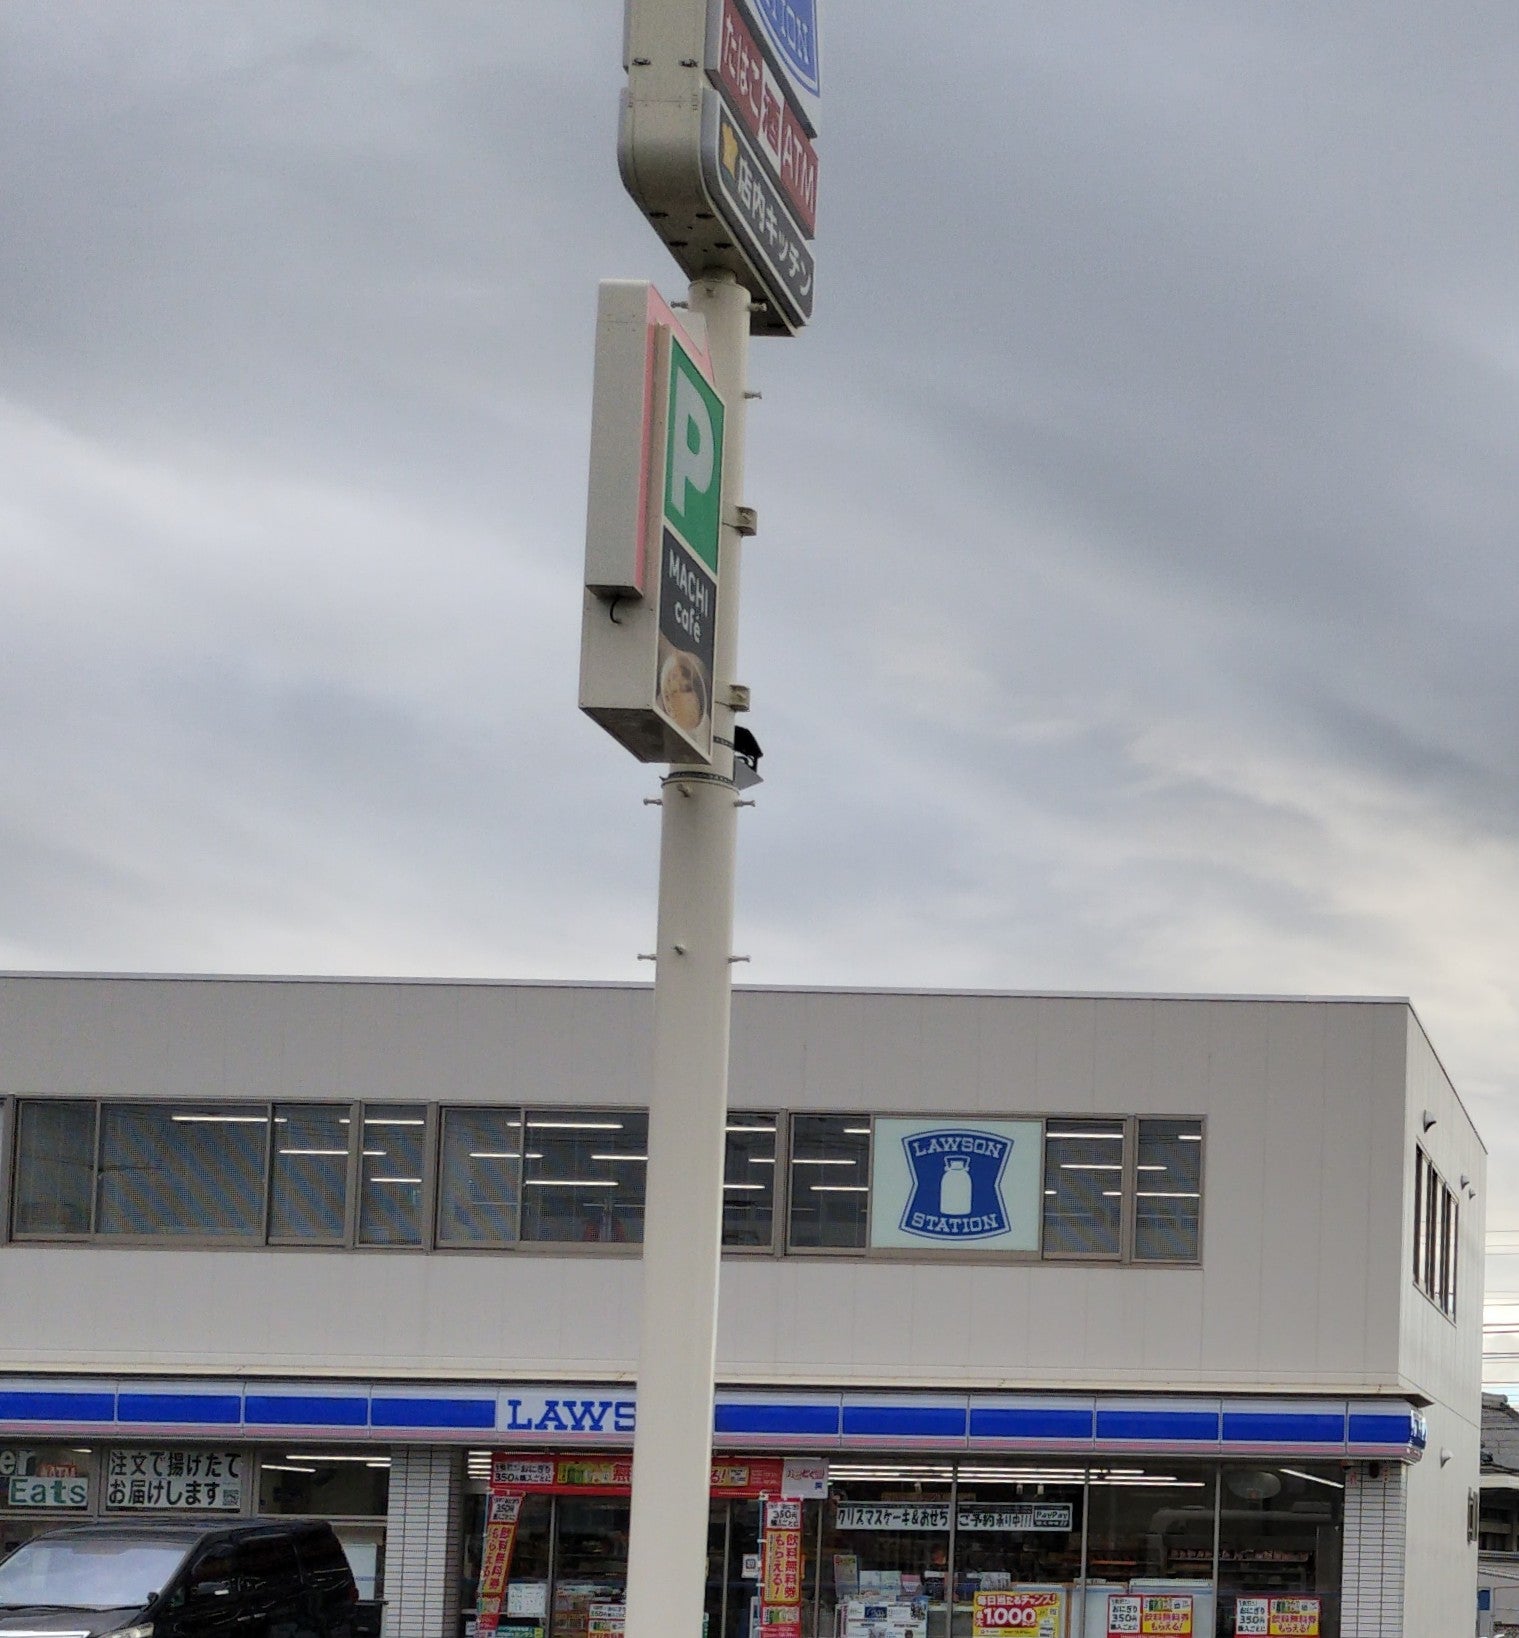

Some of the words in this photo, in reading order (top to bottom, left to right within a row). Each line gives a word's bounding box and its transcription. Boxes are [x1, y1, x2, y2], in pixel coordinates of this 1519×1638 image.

[725, 14, 760, 117] たばこ
[782, 125, 814, 214] ATM
[738, 156, 812, 296] 店内キッチン
[672, 366, 715, 517] P
[669, 548, 709, 617] MACHI
[674, 599, 702, 643] café
[912, 1137, 1003, 1159] LAWSON
[911, 1212, 999, 1233] STATION
[110, 1451, 241, 1478] 注文で揚げたて
[10, 1478, 86, 1504] Eats
[109, 1479, 219, 1505] お届けします
